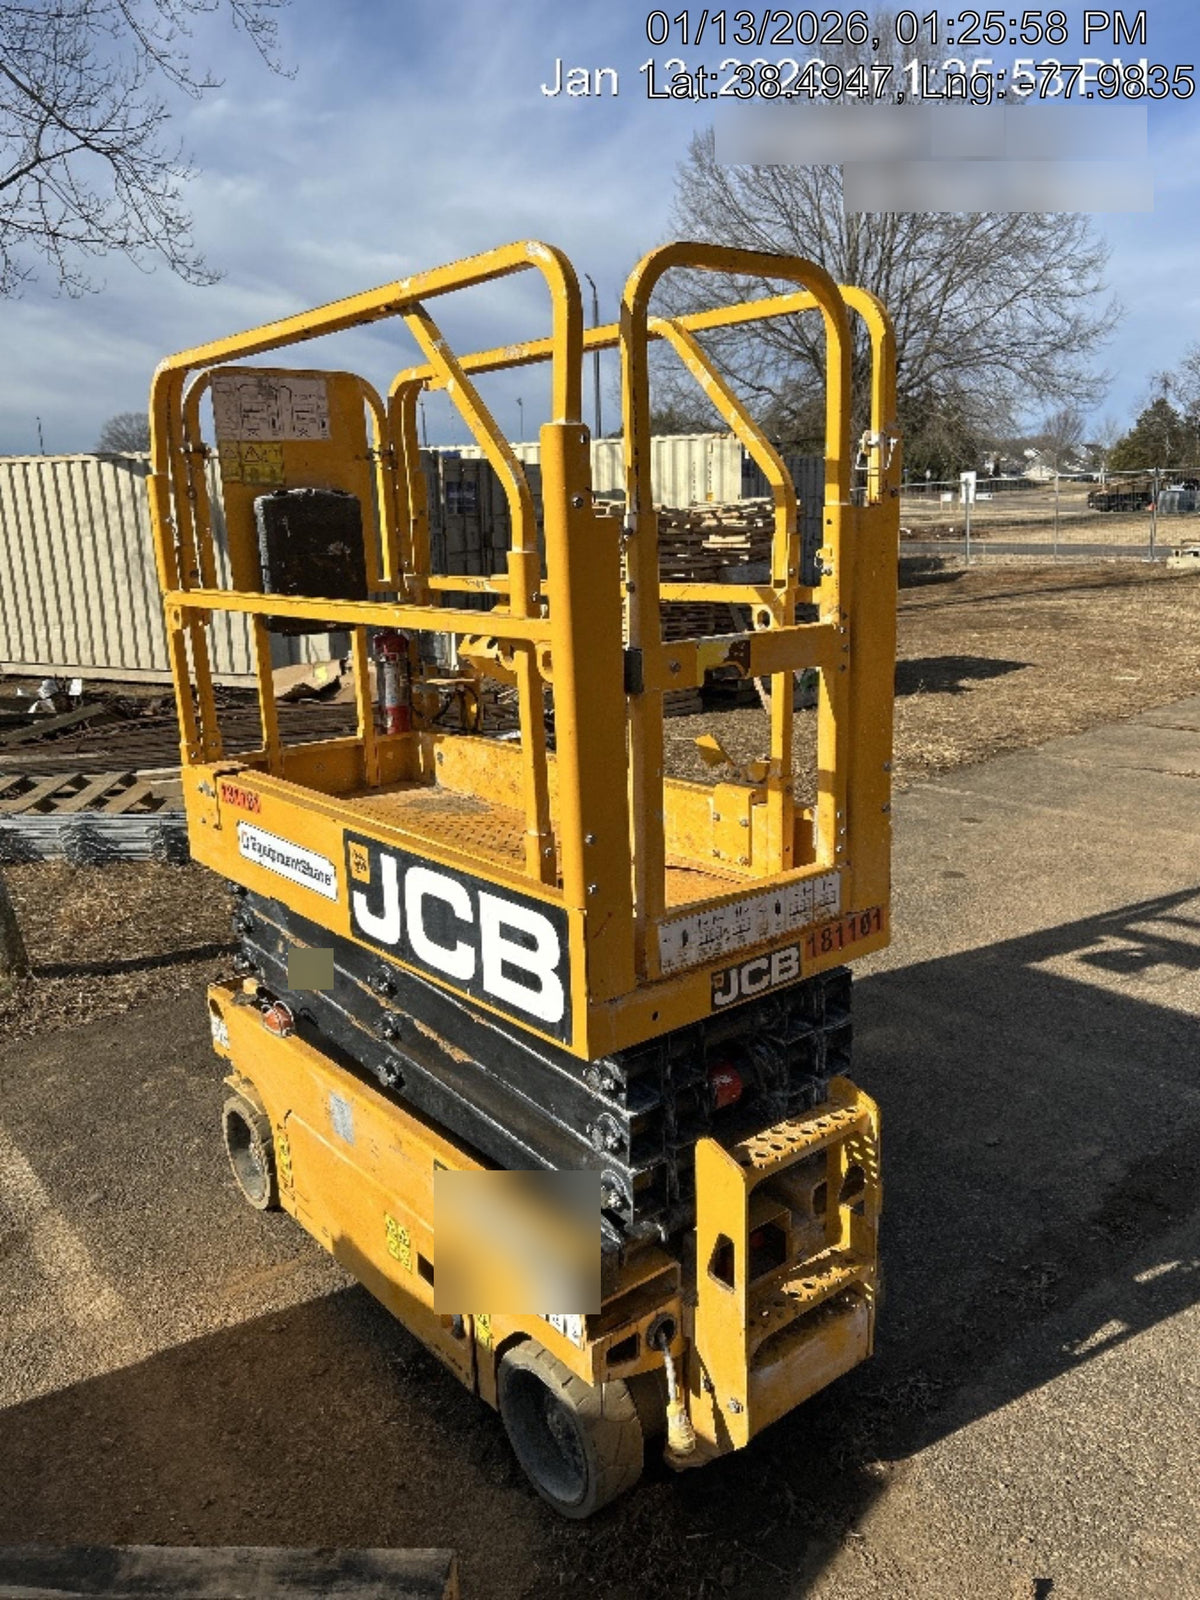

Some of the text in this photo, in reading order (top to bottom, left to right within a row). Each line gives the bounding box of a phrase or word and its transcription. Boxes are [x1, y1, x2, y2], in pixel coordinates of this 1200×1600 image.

[352, 852, 565, 1024] JCB
[807, 907, 882, 957] 181101
[713, 946, 800, 1006] JCB
